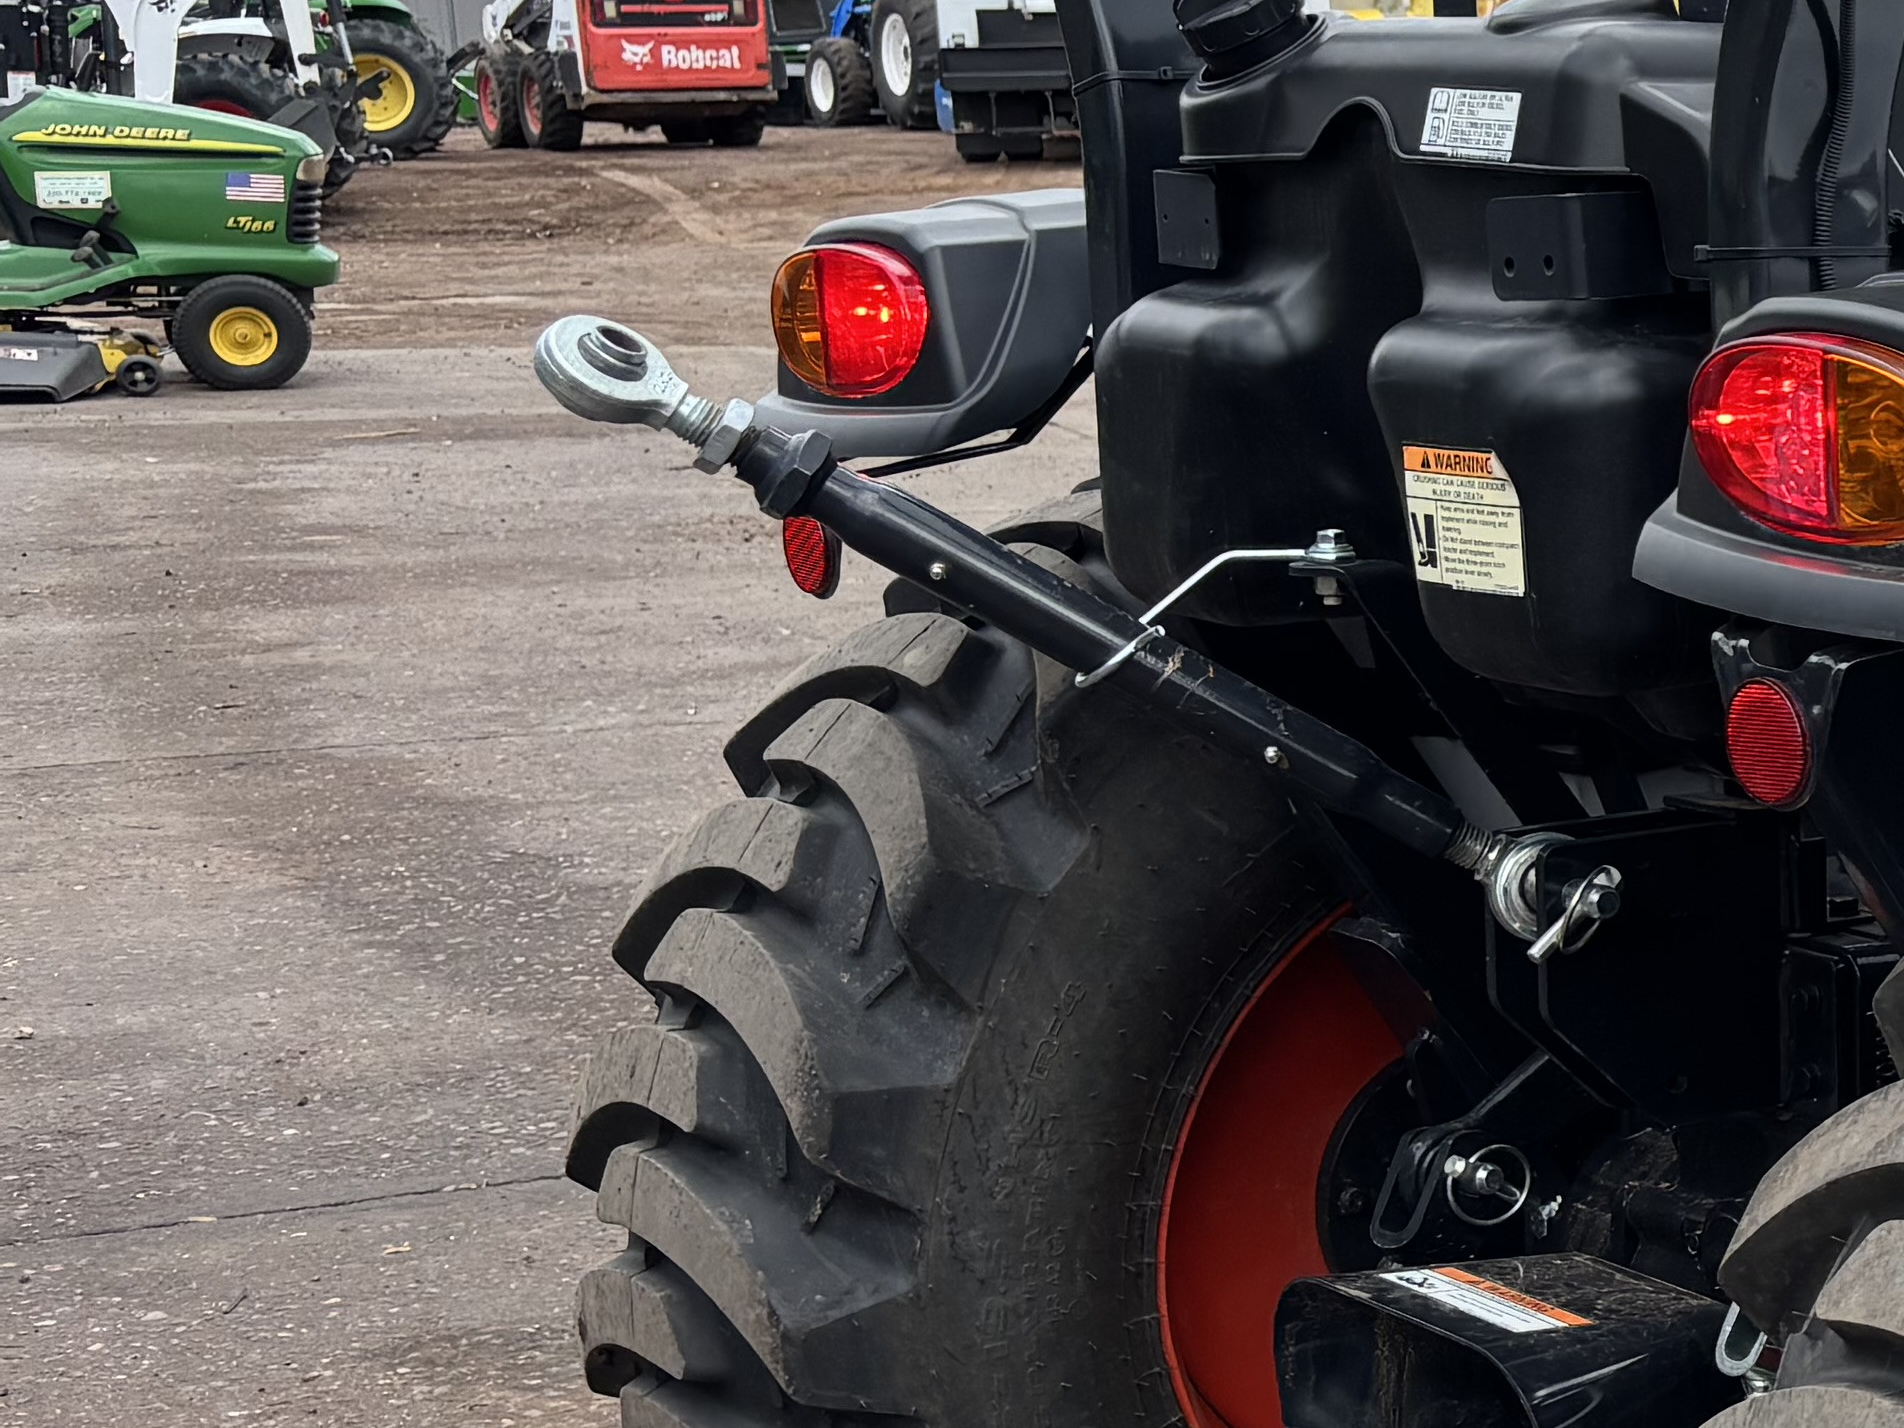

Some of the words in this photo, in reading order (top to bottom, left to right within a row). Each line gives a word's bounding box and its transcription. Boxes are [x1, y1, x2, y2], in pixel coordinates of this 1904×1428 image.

[660, 44, 742, 71] Bobcat
[41, 124, 106, 138] JOHN
[113, 125, 191, 141] DEERE
[1433, 451, 1494, 475] WARNING
